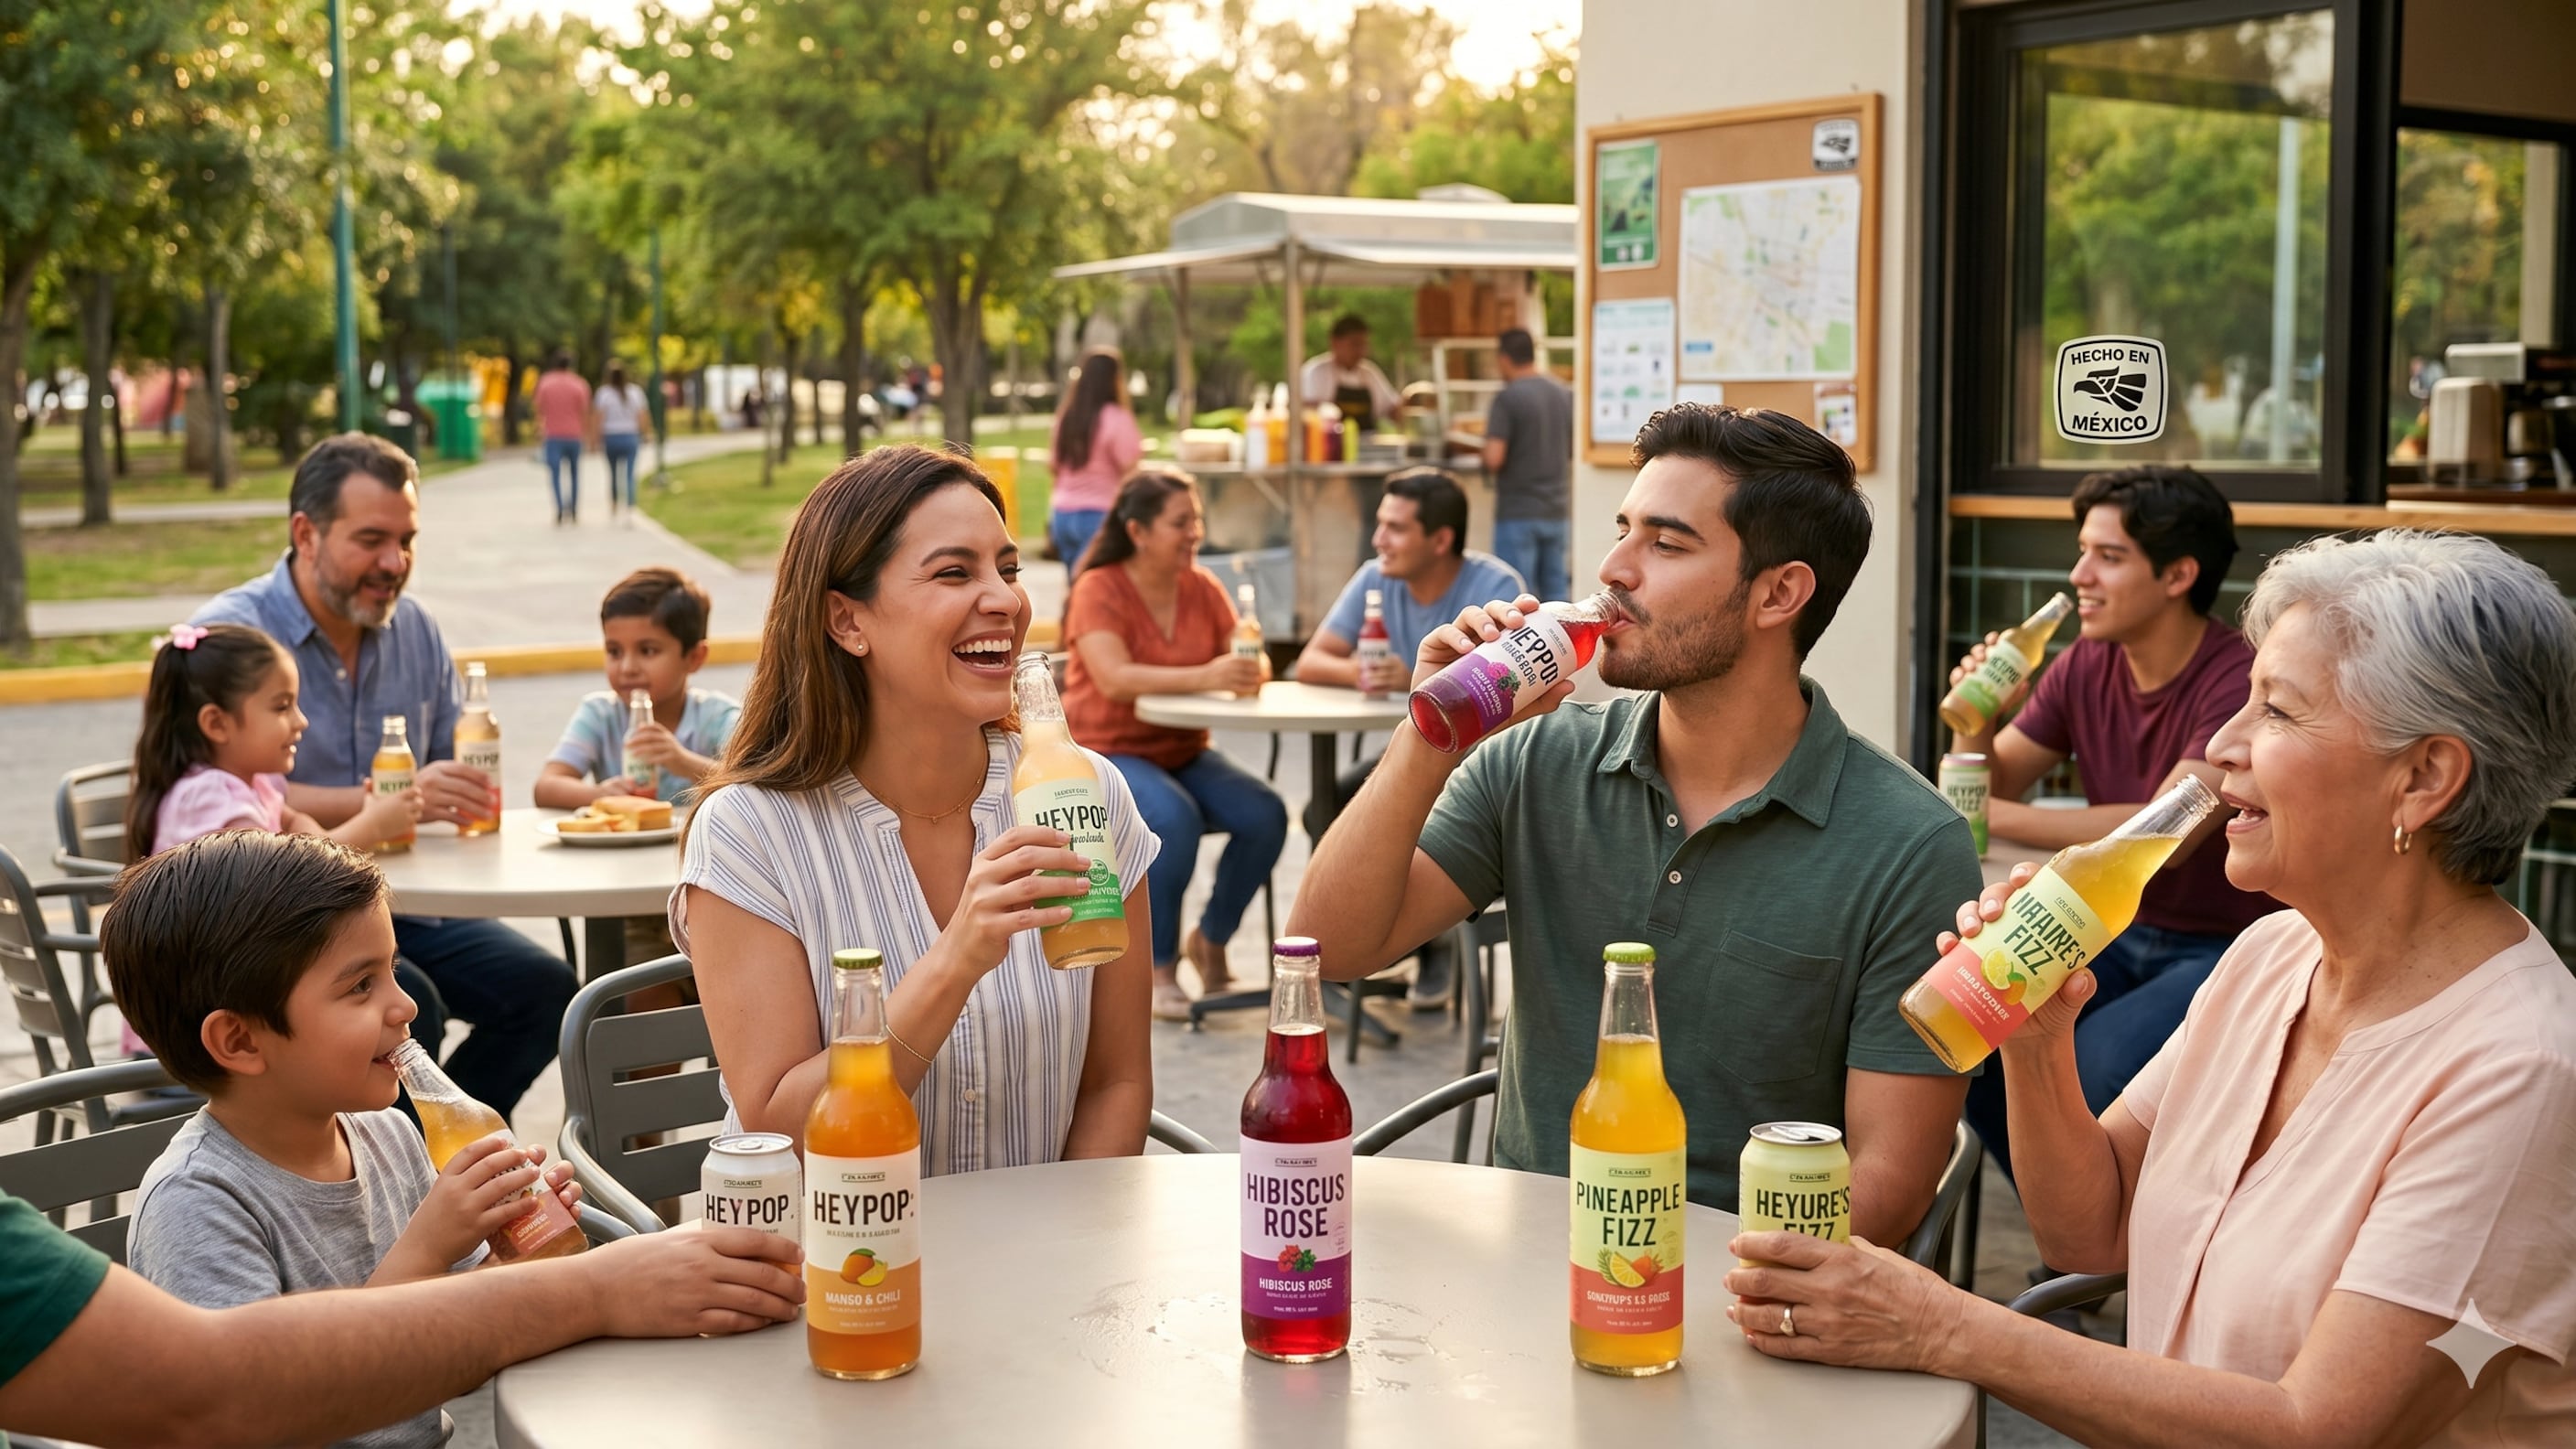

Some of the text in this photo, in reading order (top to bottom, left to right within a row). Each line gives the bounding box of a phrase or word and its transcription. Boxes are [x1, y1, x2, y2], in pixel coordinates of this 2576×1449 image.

[2071, 349, 2150, 365] HECHO EN
[2072, 411, 2148, 433] MÉXICO
[1036, 805, 1108, 832] HEYPOP
[2003, 924, 2055, 976] FIZZ
[1247, 1172, 1345, 1207] HIBISCUS
[1576, 1181, 1680, 1215] PINEAPPLE
[1756, 1186, 1850, 1220] HEYURE'S
[1264, 1207, 1328, 1239] ROSE
[1603, 1217, 1657, 1247] FIZZ
[865, 1293, 874, 1306] &
[876, 1288, 901, 1304] CHILI
[1259, 1277, 1333, 1292] HIBISCUS ROSE
